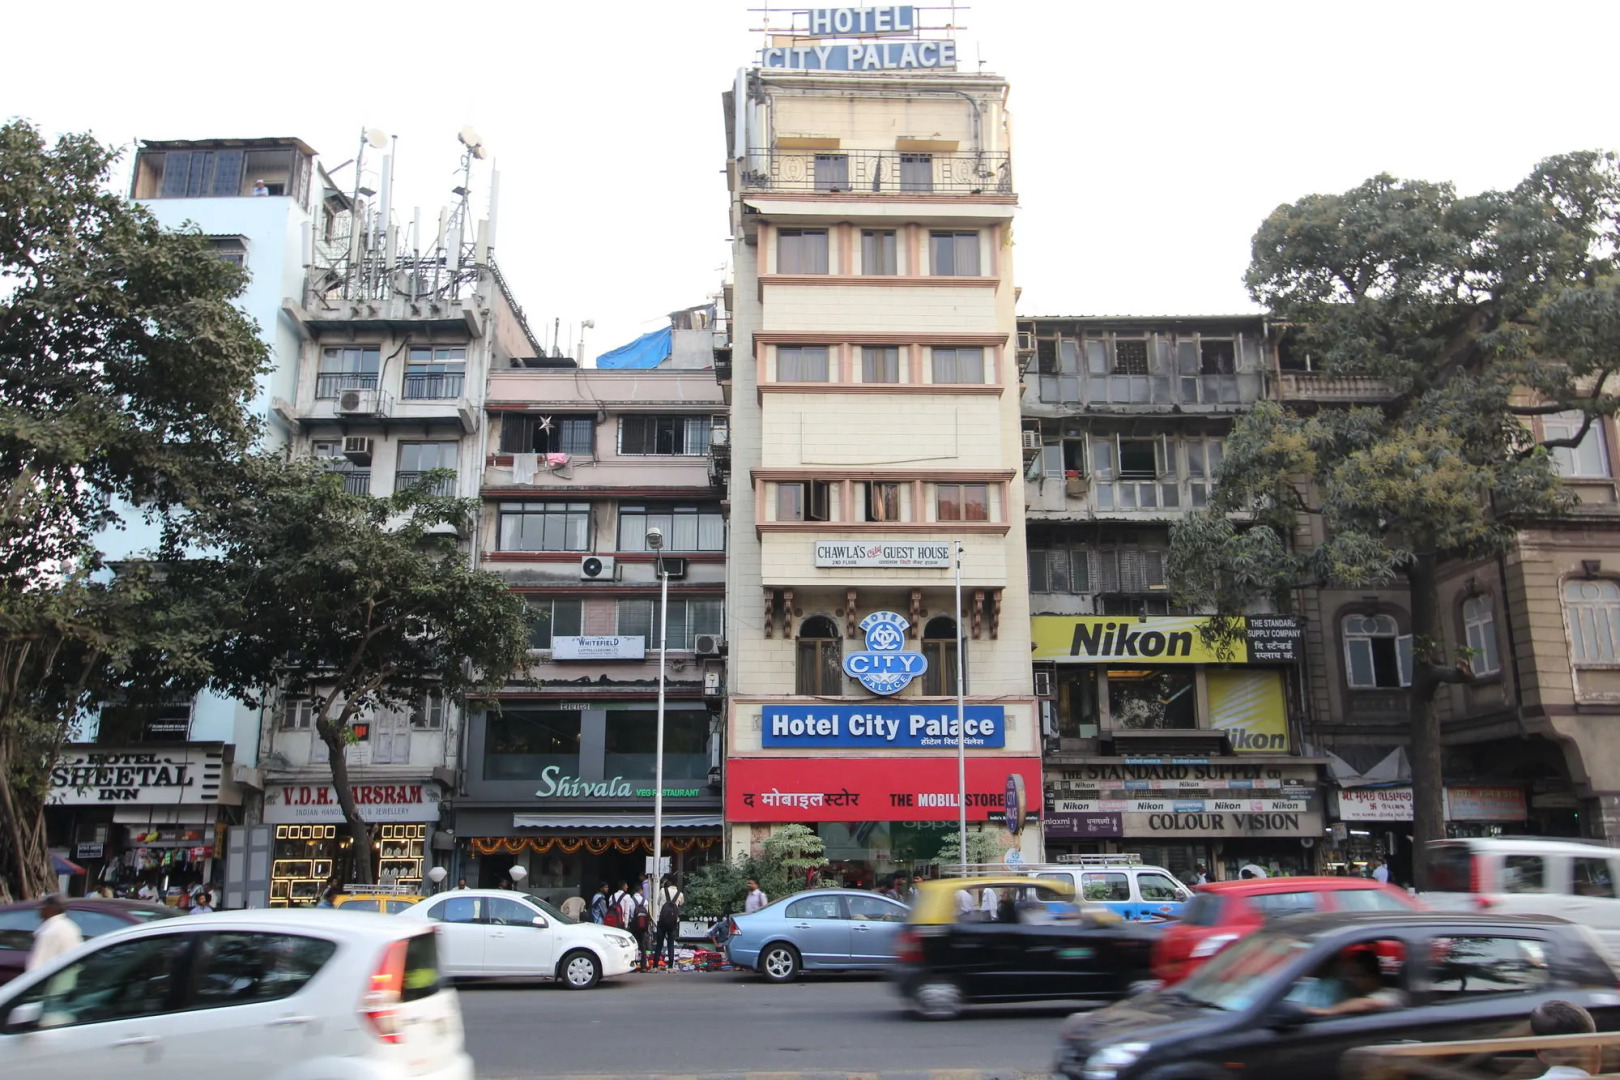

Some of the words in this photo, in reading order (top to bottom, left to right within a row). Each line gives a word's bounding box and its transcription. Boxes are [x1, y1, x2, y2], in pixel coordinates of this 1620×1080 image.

[813, 6, 911, 34] HOTEL
[763, 46, 834, 70] CITY
[847, 41, 955, 70] PALACE
[817, 545, 866, 558] CHAWLA'S
[883, 546, 914, 558] GUEST
[918, 546, 949, 559] HOUSE
[861, 612, 906, 629] HOTEL
[1251, 620, 1263, 628] THE
[1070, 622, 1193, 657] Nikon
[1248, 630, 1270, 638] SUPPLY
[1271, 630, 1300, 638] COMPANY
[579, 638, 619, 646] WHITEFIELD
[850, 656, 916, 673] CITY
[863, 675, 909, 691] PALACE
[772, 714, 839, 736] Hotel
[848, 714, 900, 741] City
[909, 714, 994, 736] Palace
[87, 753, 162, 765] HOTEL
[51, 766, 193, 787] SHEETAL
[1062, 769, 1082, 780] THE
[1088, 764, 1188, 780] STANDARD
[1195, 765, 1264, 780] SUPPLY
[536, 766, 632, 798] Shivala
[636, 788, 650, 796] VEG
[652, 788, 700, 796] RSTAURANT
[98, 788, 140, 800] INN
[283, 786, 334, 806] V.D.H.
[338, 784, 422, 805] ARSRAM
[742, 793, 756, 808] द
[890, 794, 914, 806] THE
[918, 793, 1005, 807] MOBILSTORE
[296, 808, 318, 816] INDIAN
[322, 808, 364, 816] HANDIS
[1062, 802, 1090, 810] Nikon
[1138, 802, 1164, 810] Nikon
[1214, 802, 1241, 810] Nikon
[1272, 802, 1298, 810] Nikon
[1148, 813, 1224, 830] COLOUR
[1232, 814, 1300, 830] VISION
